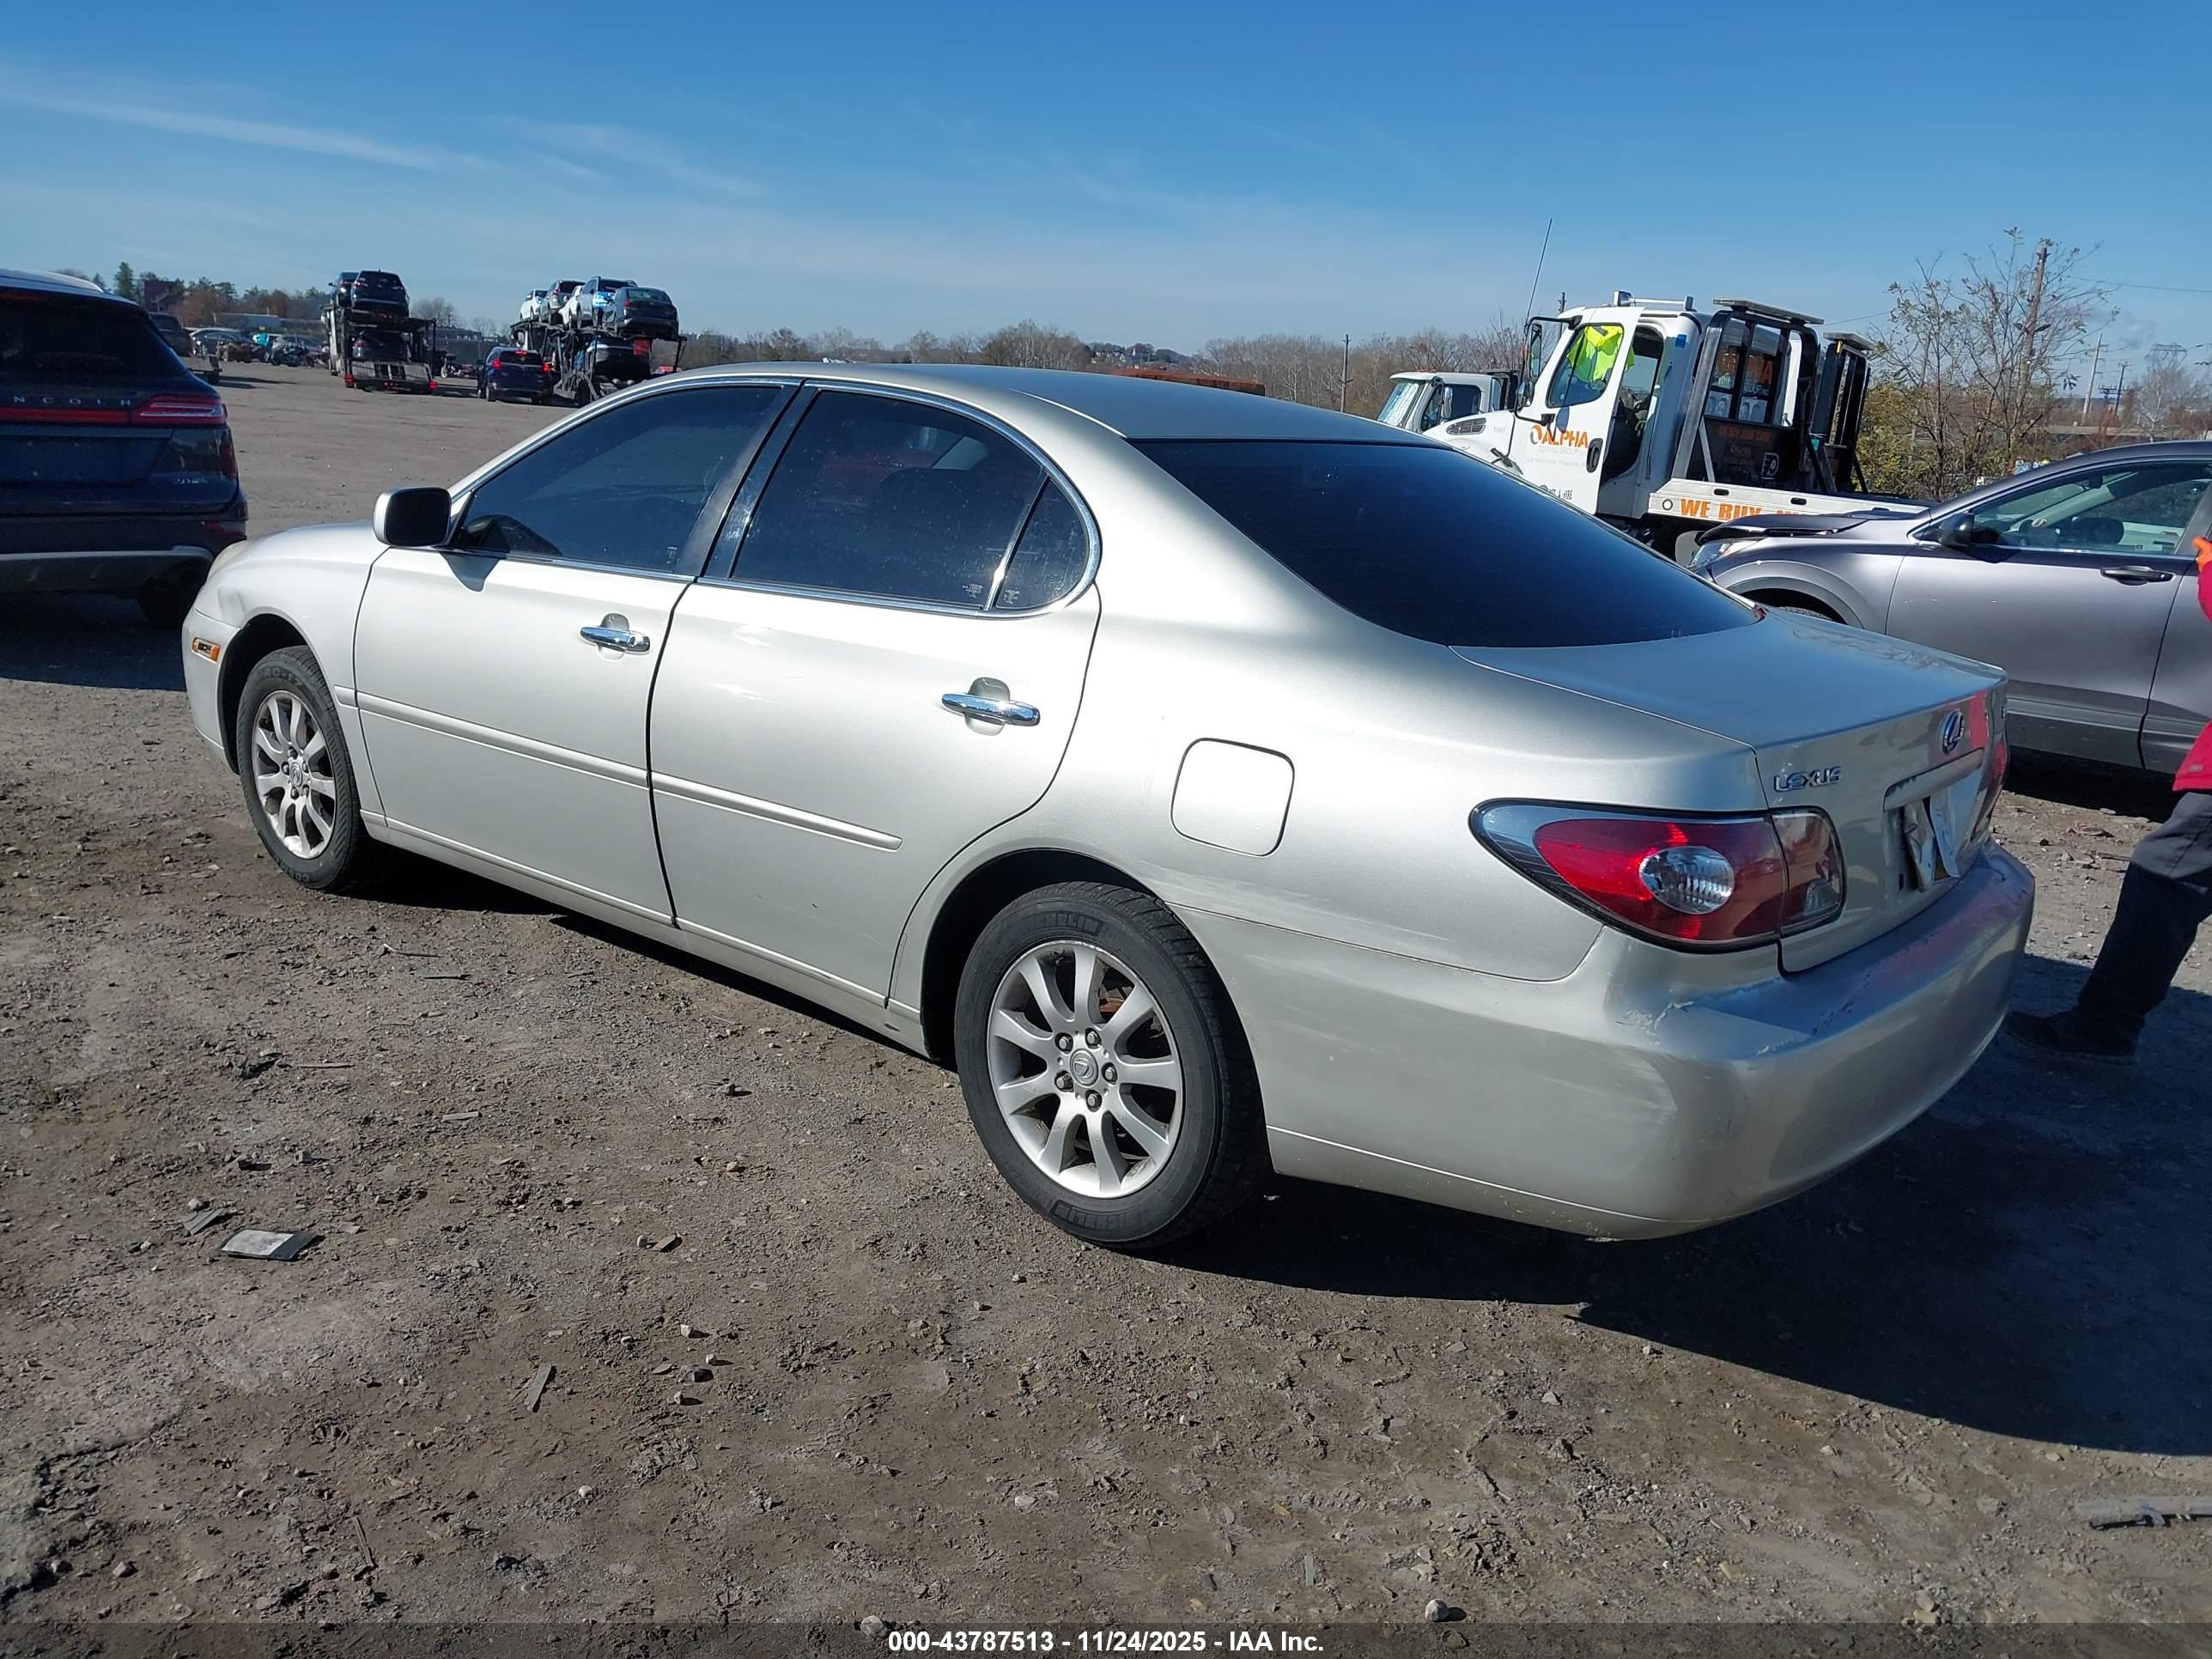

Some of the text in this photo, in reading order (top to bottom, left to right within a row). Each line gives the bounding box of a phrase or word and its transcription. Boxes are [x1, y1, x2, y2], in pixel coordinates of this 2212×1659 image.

[1540, 429, 1589, 447] ALPHA
[1680, 498, 1763, 521] WE BUY
[1773, 766, 1841, 793] LEXUS
